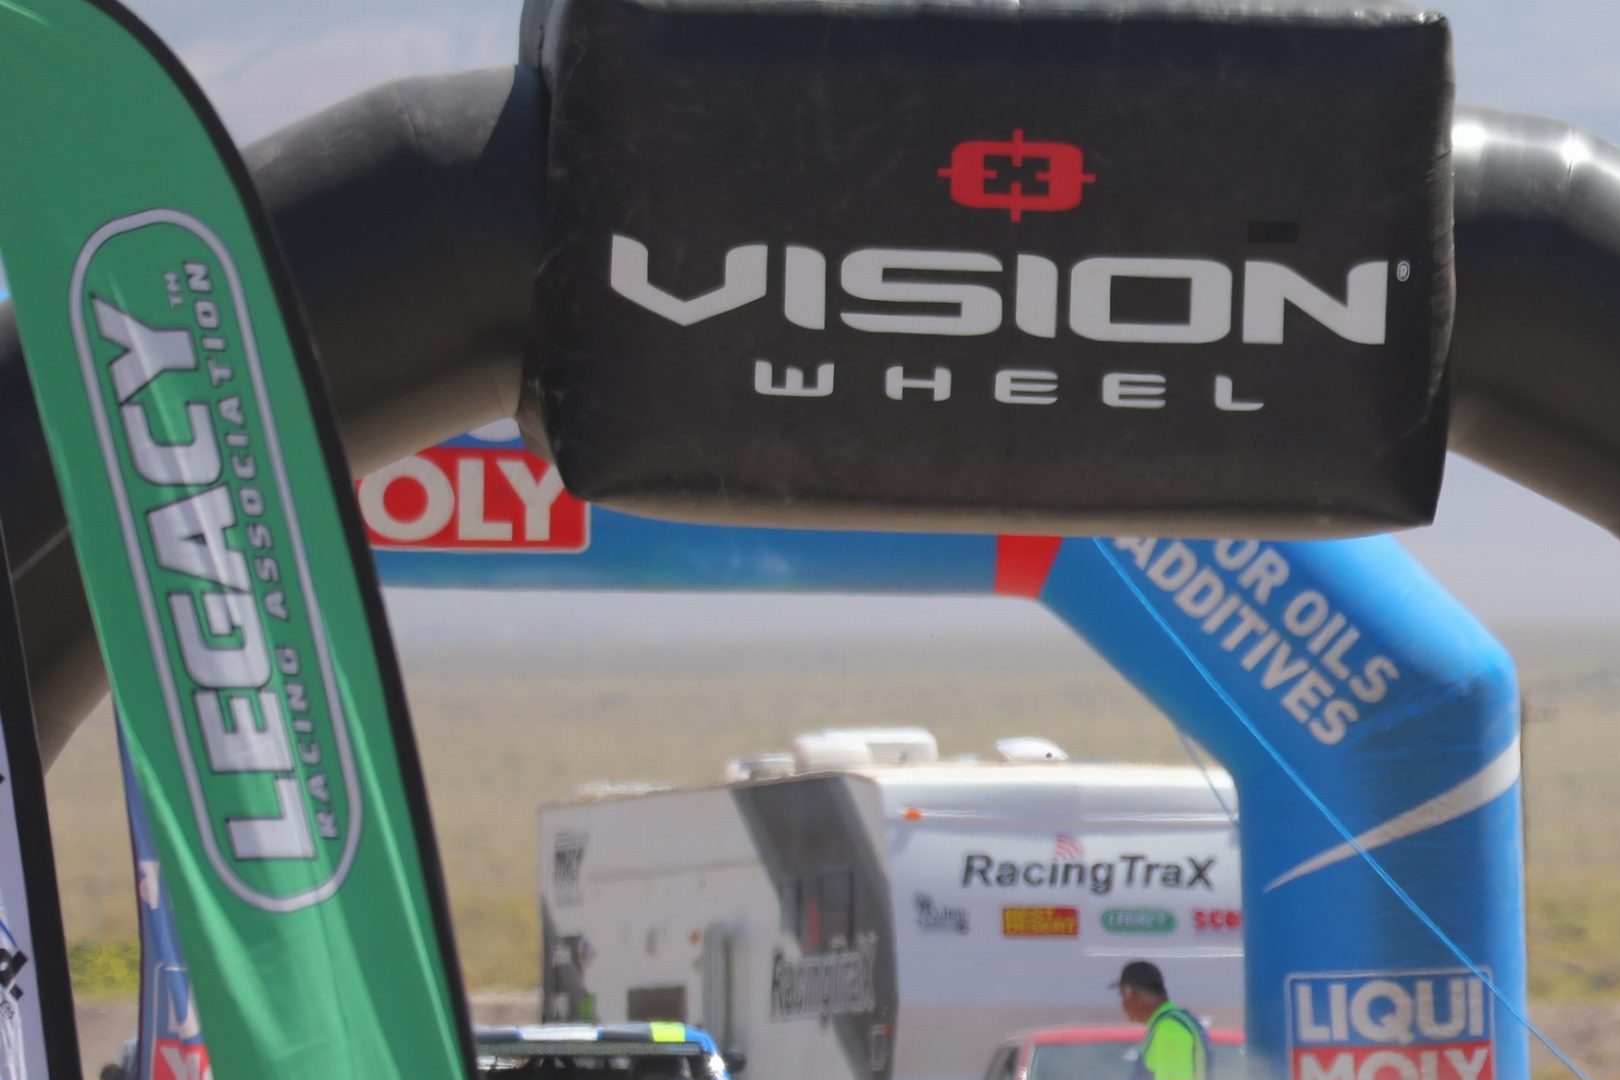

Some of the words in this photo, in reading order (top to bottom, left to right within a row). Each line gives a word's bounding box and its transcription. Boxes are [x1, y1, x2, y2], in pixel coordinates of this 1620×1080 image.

[610, 233, 1388, 346] VISION
[183, 261, 290, 622] ASSOCIATION
[754, 360, 1264, 412] WHEEL
[358, 455, 566, 543] OLY
[90, 294, 317, 861] LEGACY
[1113, 537, 1360, 746] ADDITIVES
[1283, 589, 1400, 704] OILS
[277, 645, 340, 839] RACING
[961, 854, 1218, 895] RacingTraX
[1299, 979, 1484, 1047] LIQUI
